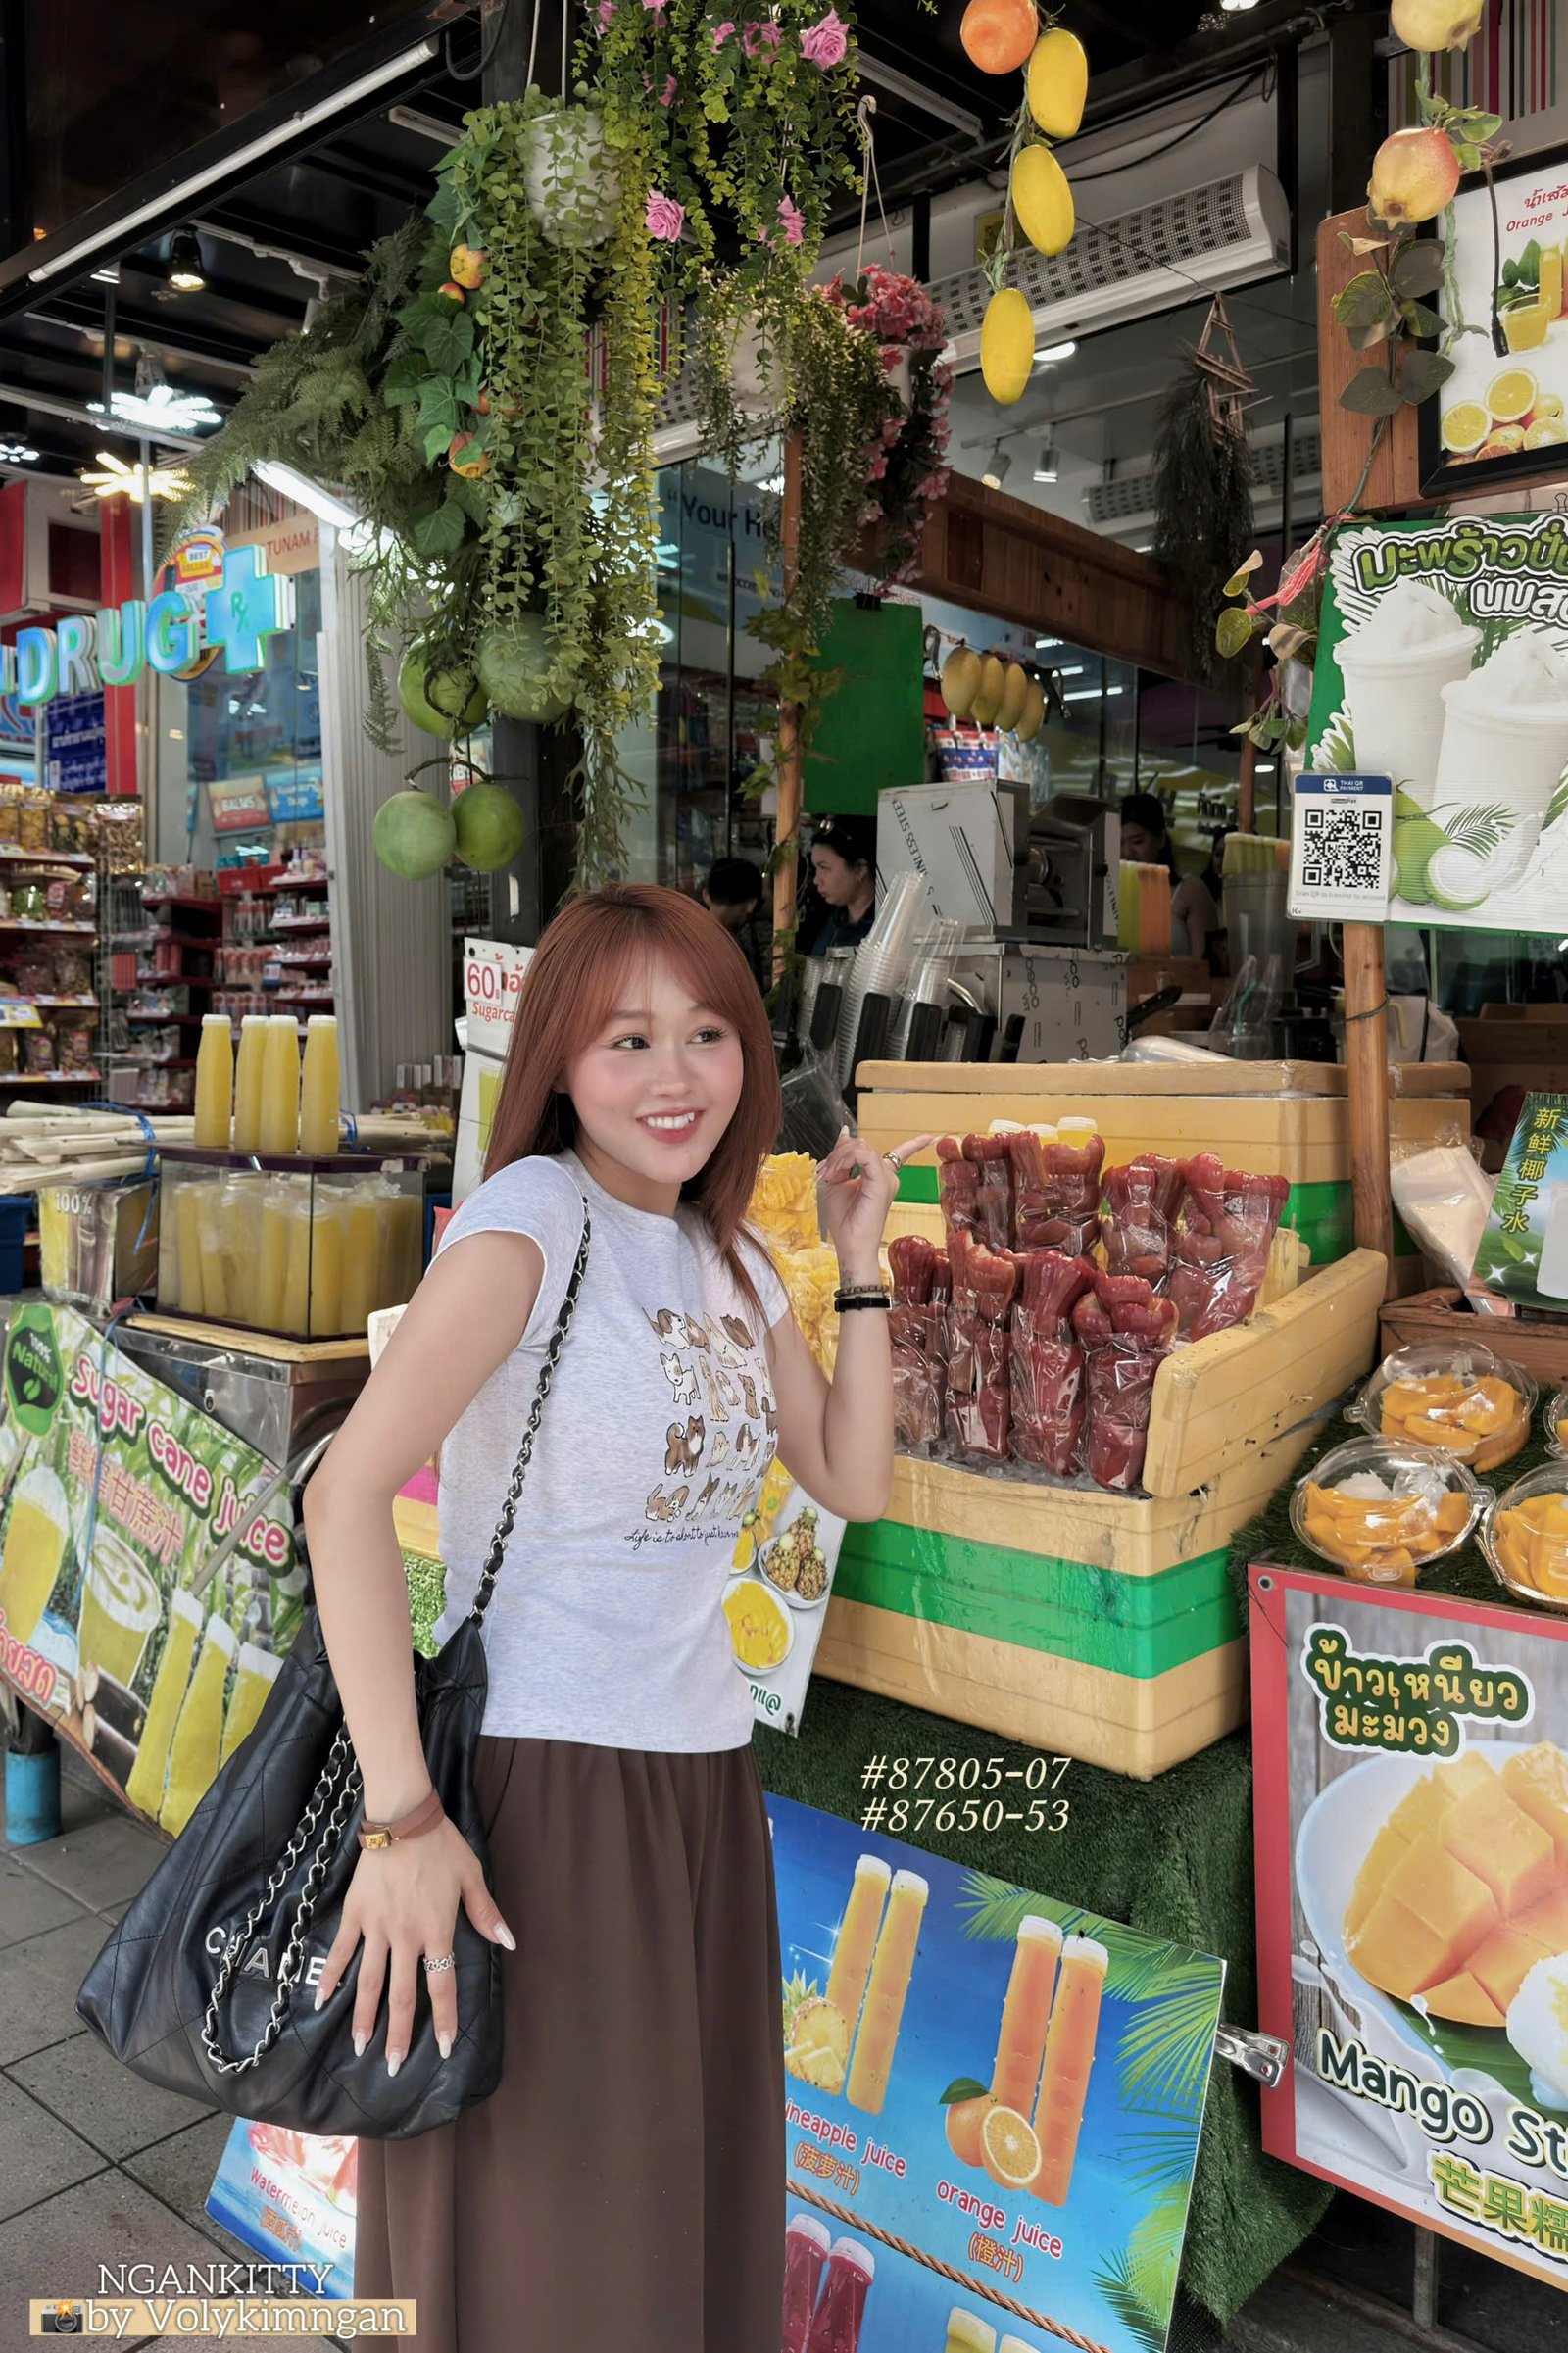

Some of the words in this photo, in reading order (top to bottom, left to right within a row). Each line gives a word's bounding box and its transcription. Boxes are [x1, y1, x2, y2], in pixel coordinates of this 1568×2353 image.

[1506, 212, 1553, 232] Orange
[16, 590, 199, 706] DRUG
[467, 963, 495, 999] 60
[472, 1001, 515, 1022] Sugarca
[1501, 1107, 1561, 1234] 新鲜椰子水
[56, 1192, 92, 1215] 100%
[74, 1356, 144, 1432] sugar
[149, 1427, 211, 1503] cane
[1314, 1638, 1518, 1711] ข้าวเหนียว
[1334, 1698, 1450, 1747] มะม่วง
[1321, 2033, 1483, 2135] Mango
[1507, 2110, 1568, 2173] St
[860, 2138, 906, 2178] juice
[317, 2218, 347, 2250] juice
[937, 2181, 1005, 2229] orange
[1011, 2216, 1062, 2258] juice
[1434, 2158, 1568, 2253] 芒果糯
